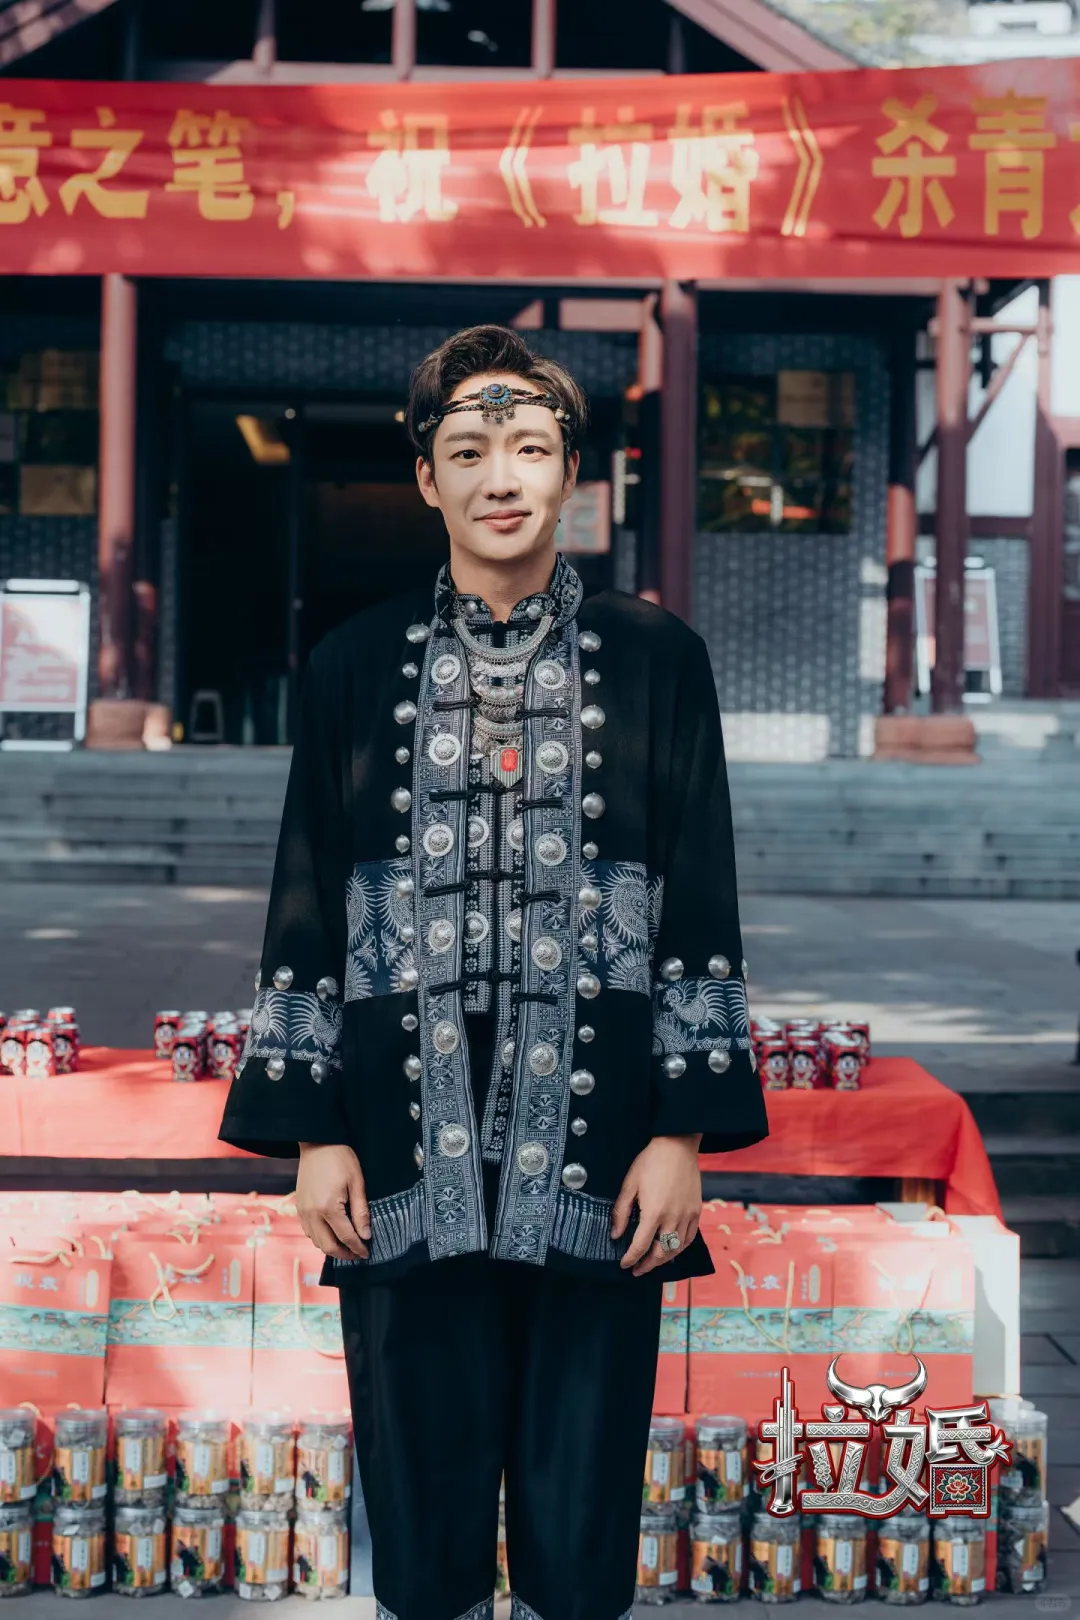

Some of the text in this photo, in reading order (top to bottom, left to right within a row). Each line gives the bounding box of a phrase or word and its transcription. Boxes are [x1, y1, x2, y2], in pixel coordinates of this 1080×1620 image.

[0, 89, 1080, 240] 意之笔，祝《拉婚》杀青
